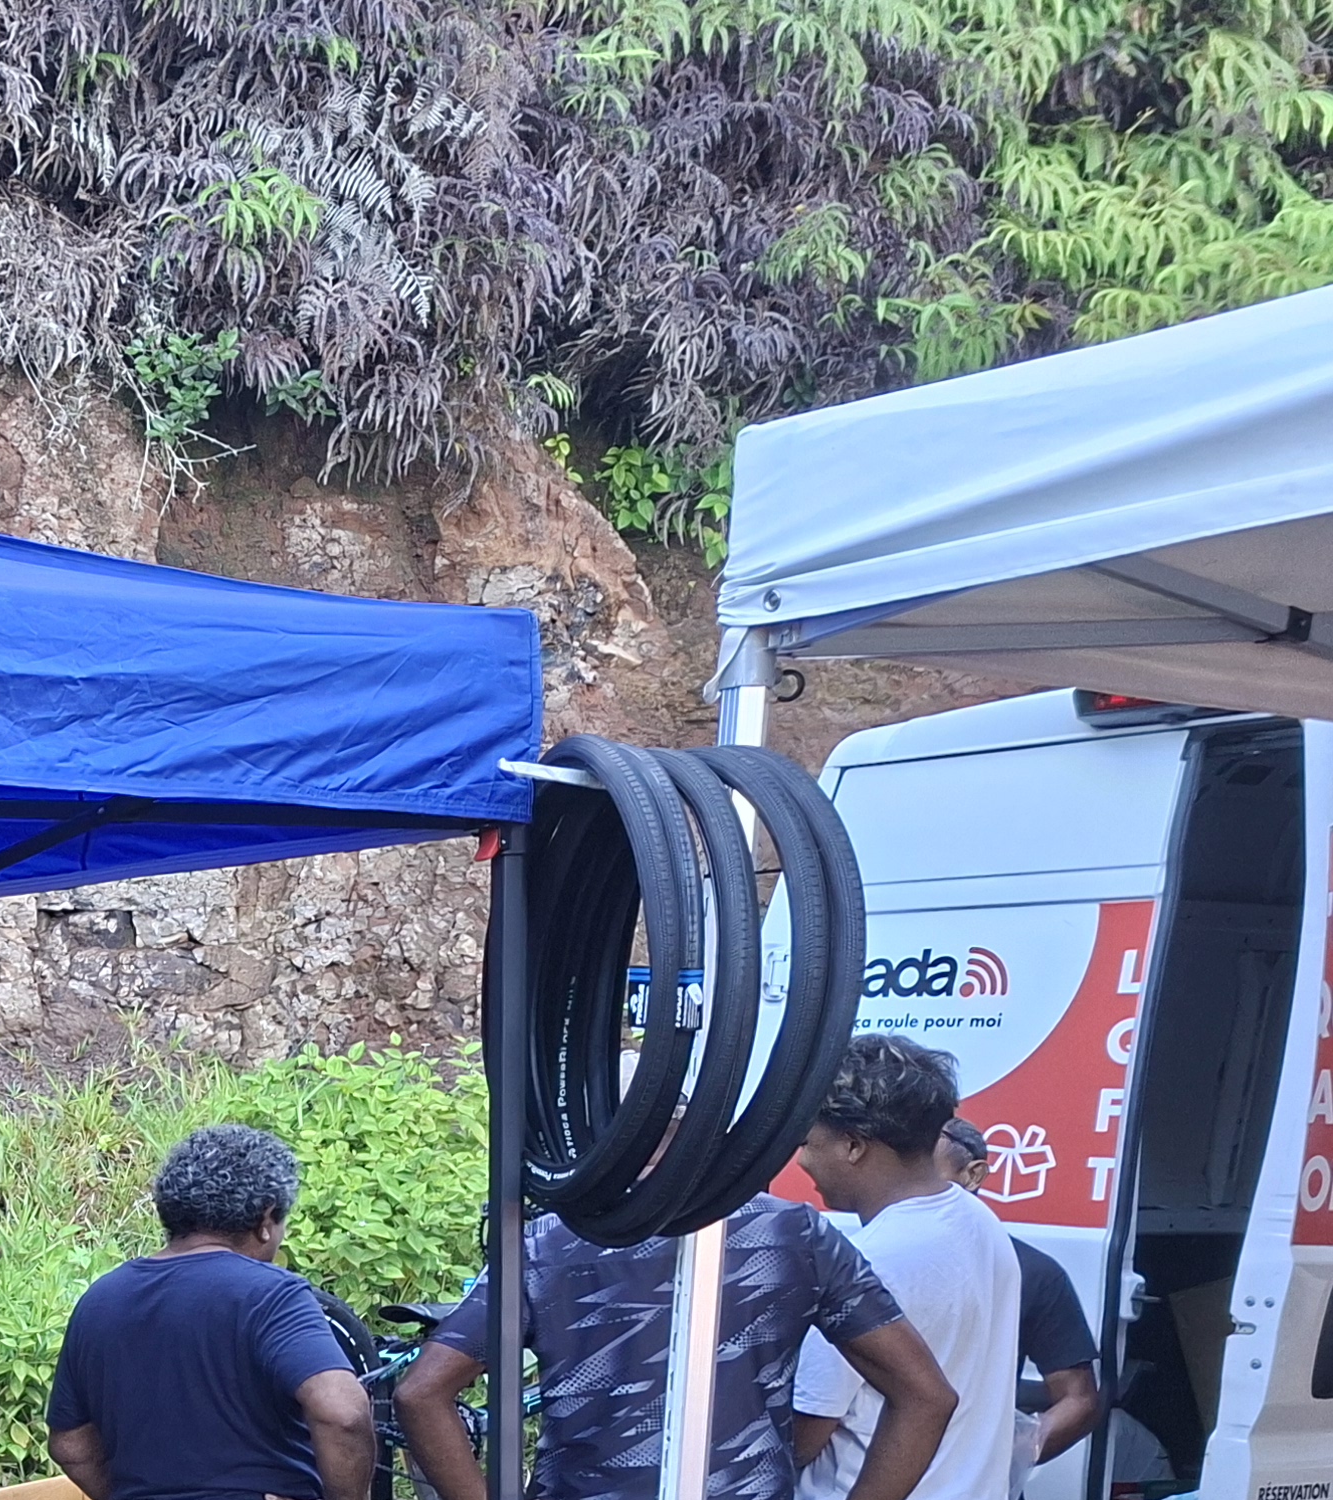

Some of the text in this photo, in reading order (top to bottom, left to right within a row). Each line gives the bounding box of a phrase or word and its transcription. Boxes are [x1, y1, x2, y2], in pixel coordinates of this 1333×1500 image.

[862, 948, 958, 998] ada
[876, 1013, 919, 1029] roule
[924, 1013, 964, 1031] pour
[969, 1012, 1002, 1028] moi
